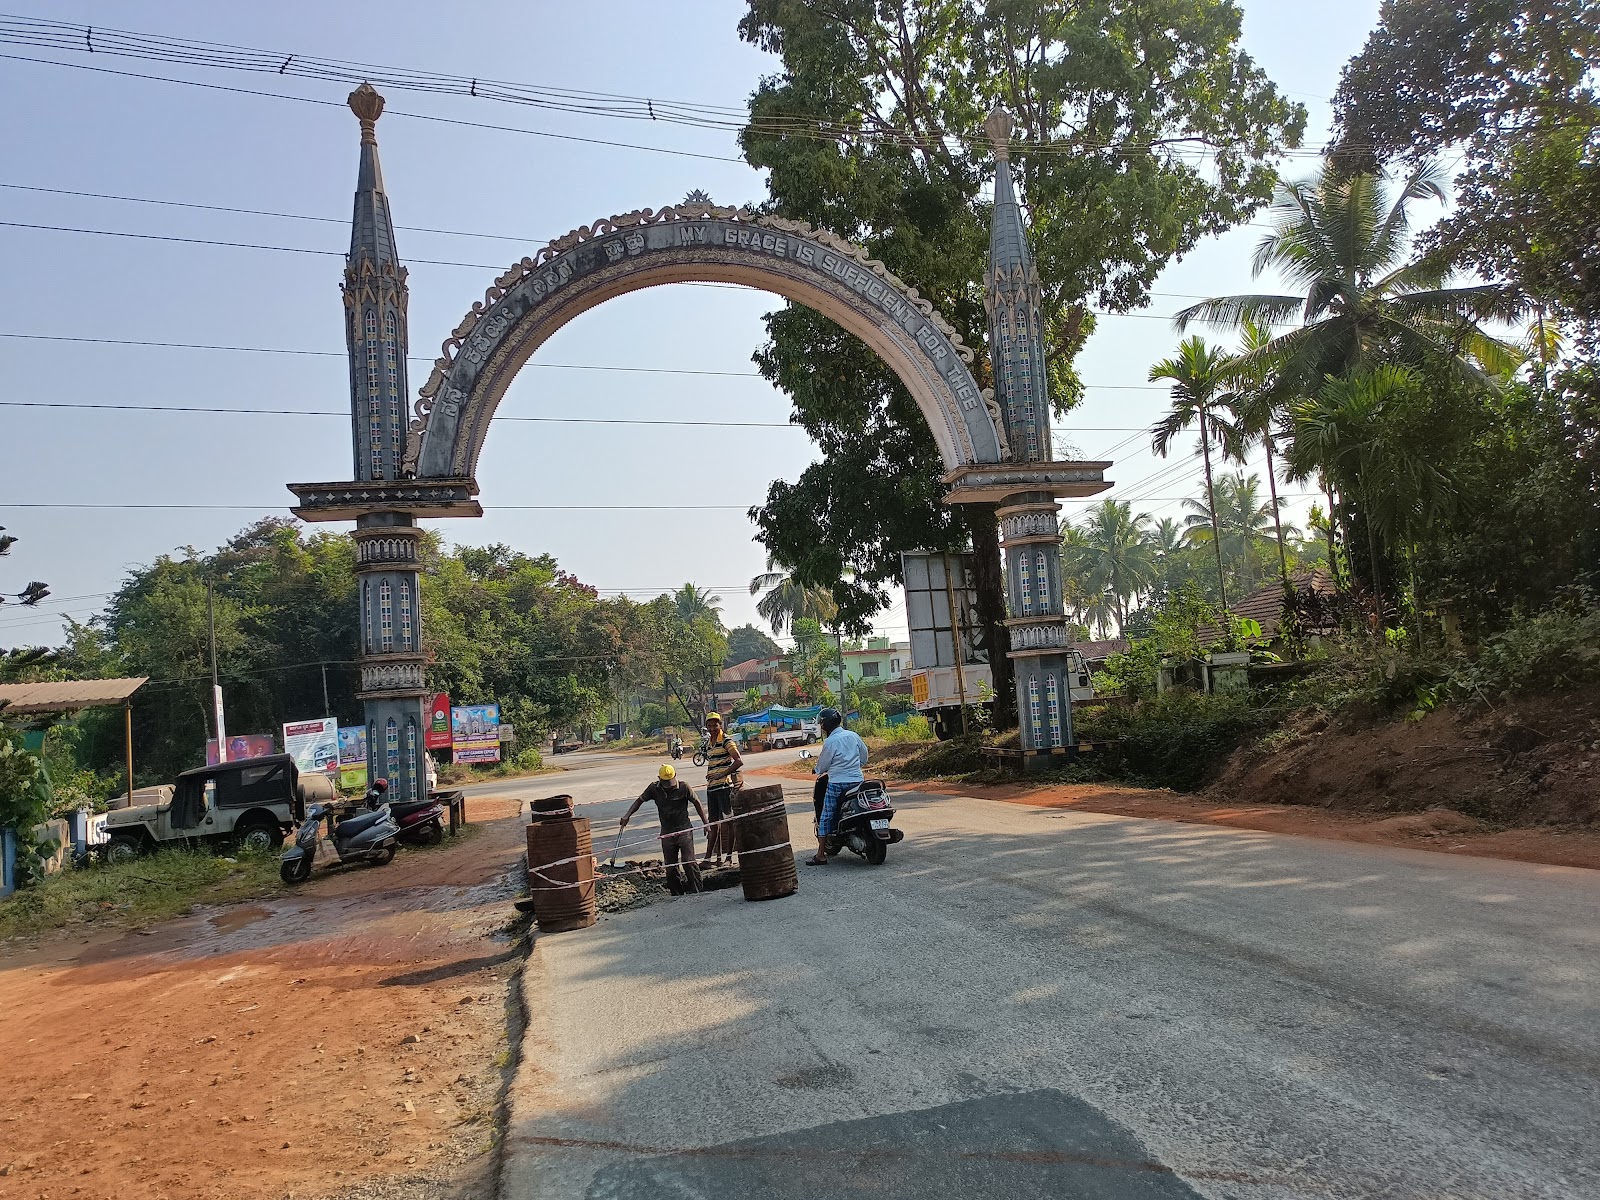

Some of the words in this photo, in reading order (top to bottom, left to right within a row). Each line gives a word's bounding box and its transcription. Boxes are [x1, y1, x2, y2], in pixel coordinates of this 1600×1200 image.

[680, 226, 706, 244] MY
[724, 228, 788, 257] GRACE
[796, 244, 814, 266] IS
[821, 255, 916, 325] SUFFICIENT
[916, 325, 948, 361] FOR
[946, 363, 978, 412] THEE
[441, 387, 467, 417] ನನ್ನ
